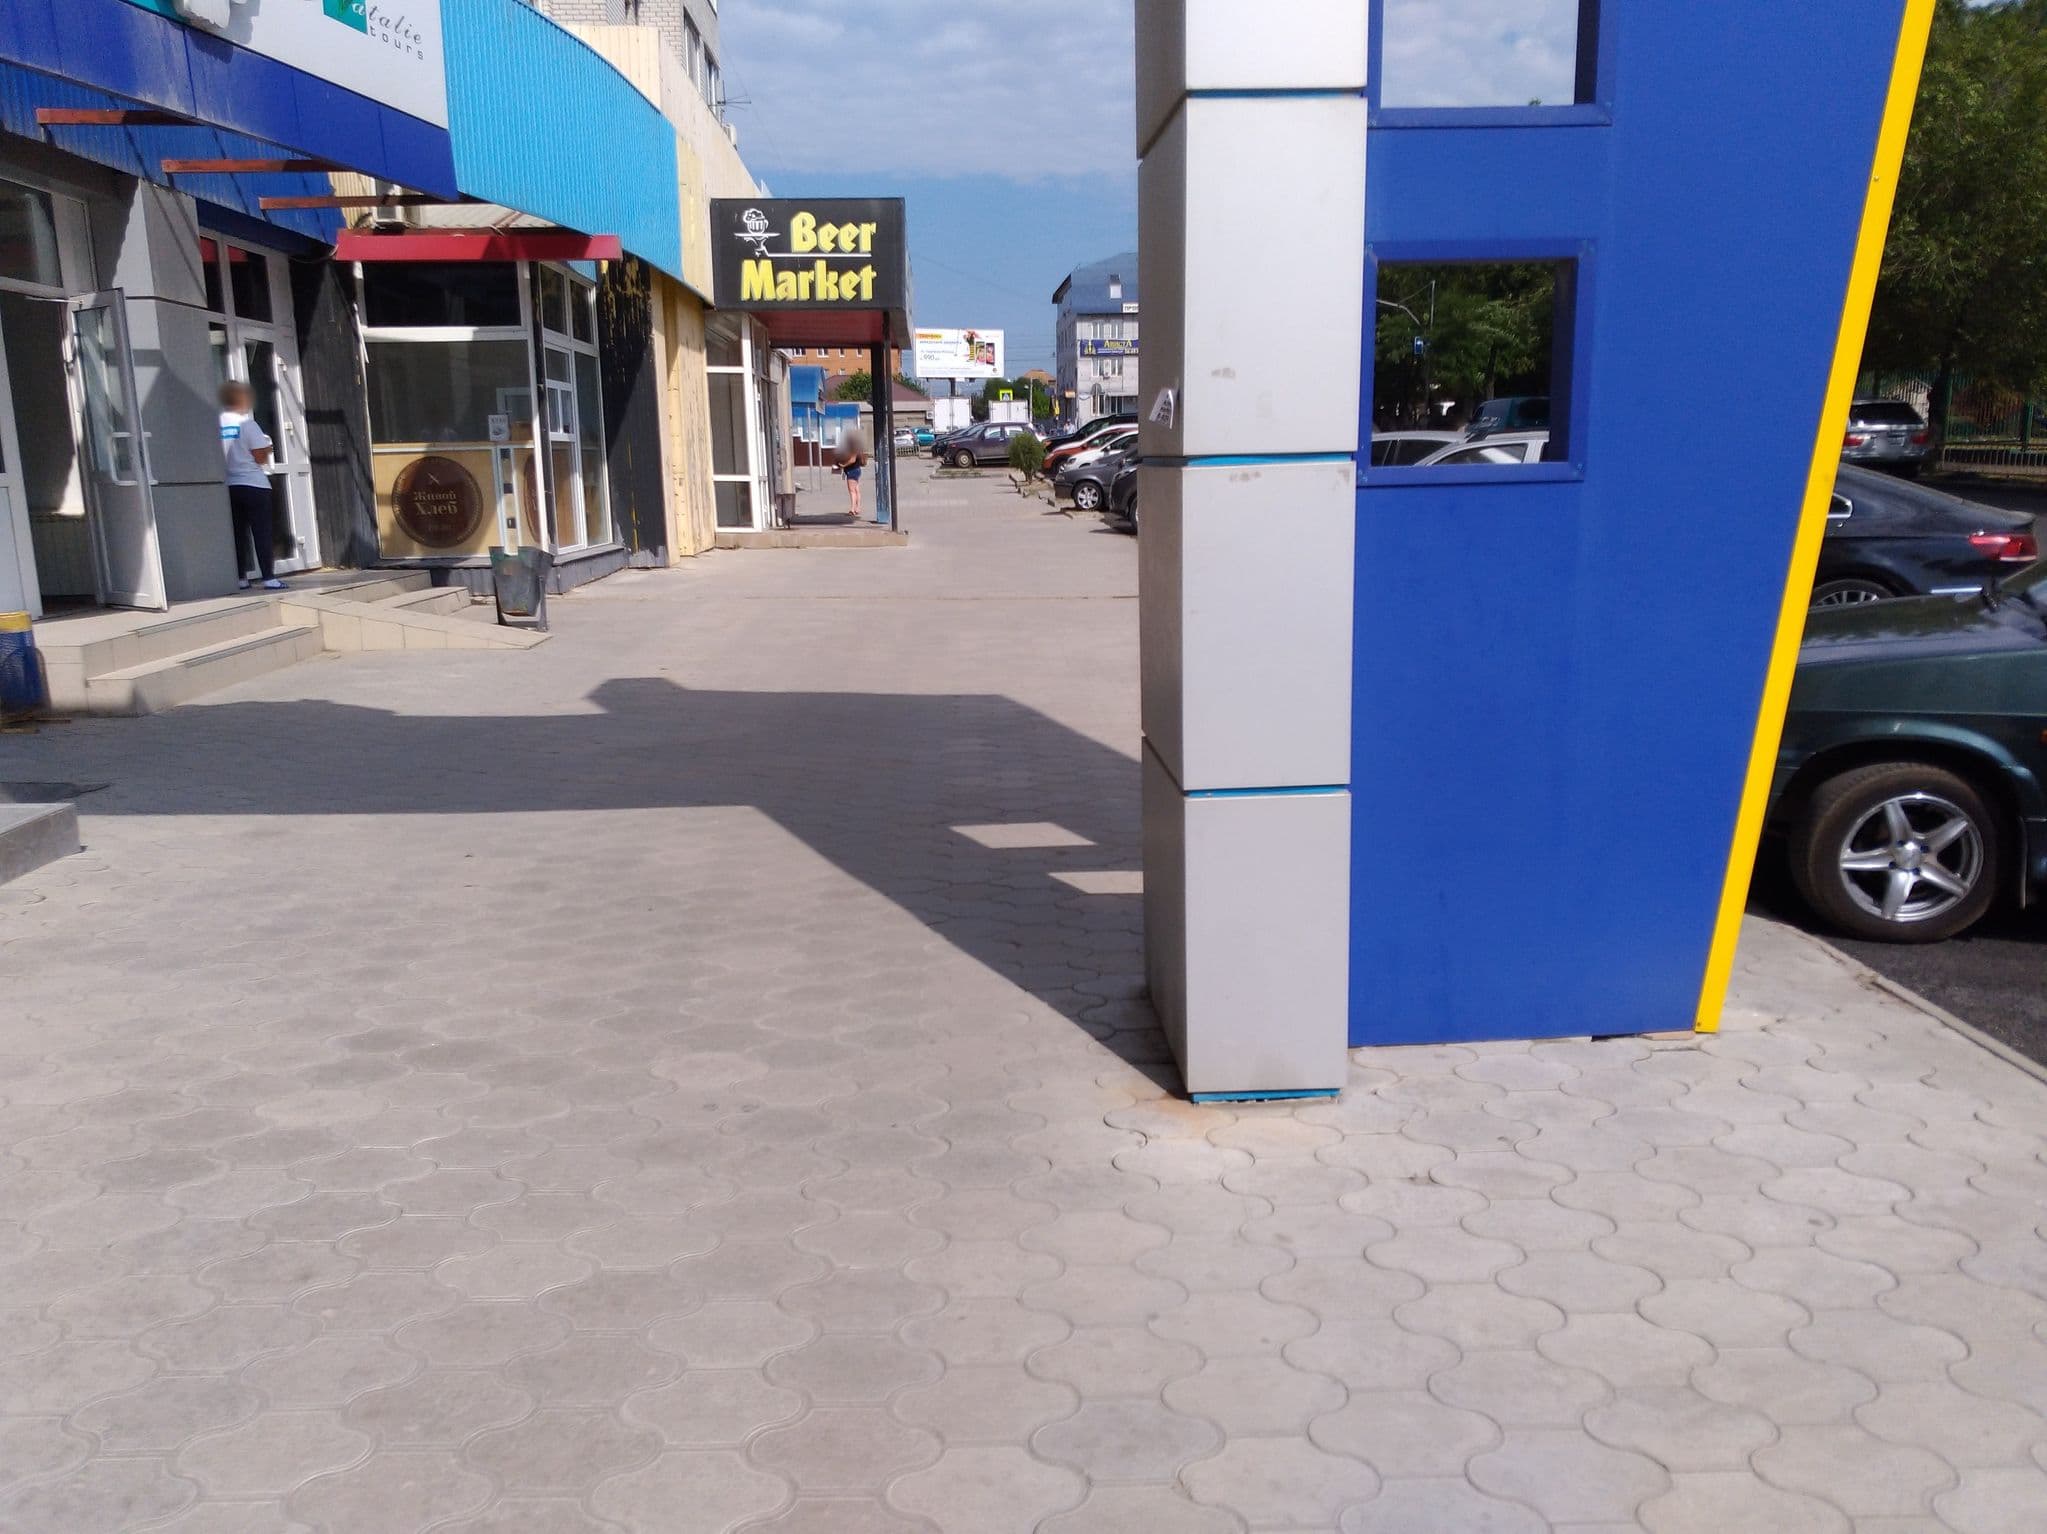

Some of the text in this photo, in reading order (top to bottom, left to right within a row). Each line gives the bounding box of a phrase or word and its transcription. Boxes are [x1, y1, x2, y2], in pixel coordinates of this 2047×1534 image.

[344, 0, 422, 44] atalie
[369, 25, 424, 60] tours
[790, 211, 877, 253] Beer
[741, 259, 877, 301] Market
[413, 490, 457, 501] Живой
[415, 501, 458, 515] Хлеб
